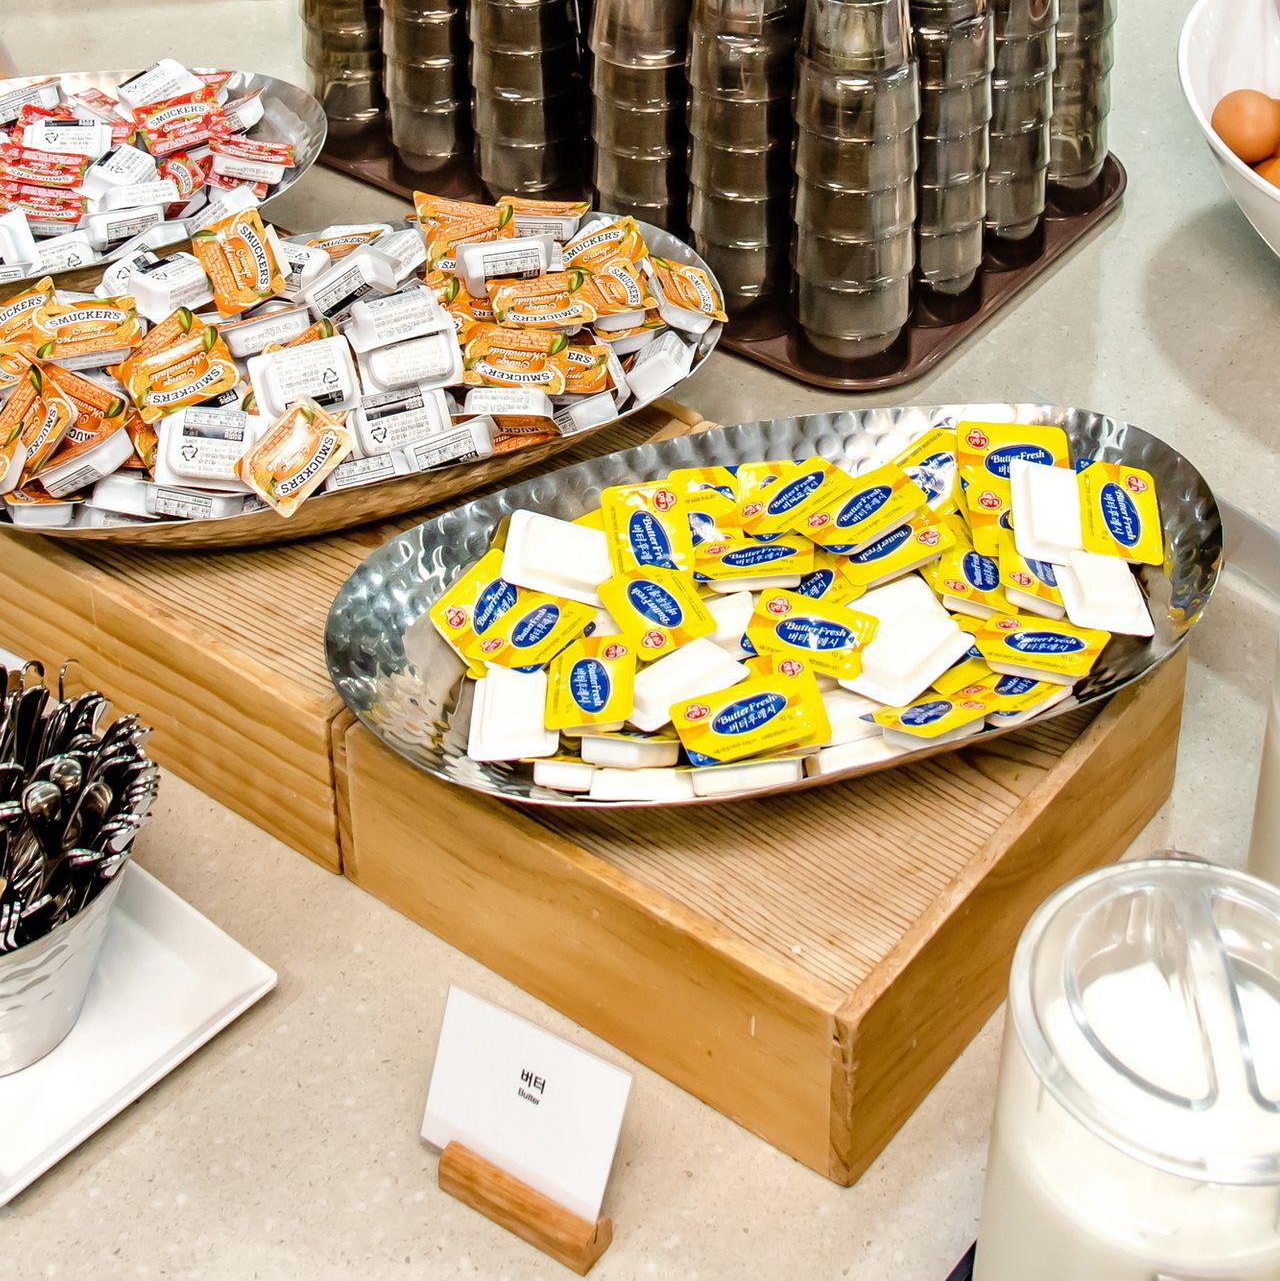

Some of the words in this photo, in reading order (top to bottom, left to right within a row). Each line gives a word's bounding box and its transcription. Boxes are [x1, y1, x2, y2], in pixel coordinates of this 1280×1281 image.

[150, 104, 206, 128] SMUCKER'S
[239, 225, 270, 287] SMUCKER'S
[563, 230, 621, 263] SMUCKER'S
[612, 268, 640, 304] SMUCKER'S
[49, 310, 122, 328] SMUCKER'S
[512, 306, 581, 323] SMUCKER'S
[152, 370, 221, 405] SMUCKER'S
[482, 364, 551, 384] SMUCKER'S
[27, 408, 56, 461] SMUCKE
[280, 436, 334, 494] SMUCKER'S
[787, 632, 838, 648] 버터레시
[728, 704, 776, 733] 버터후레시
[520, 1068, 546, 1094] 버터
[517, 1087, 540, 1105] Butter
